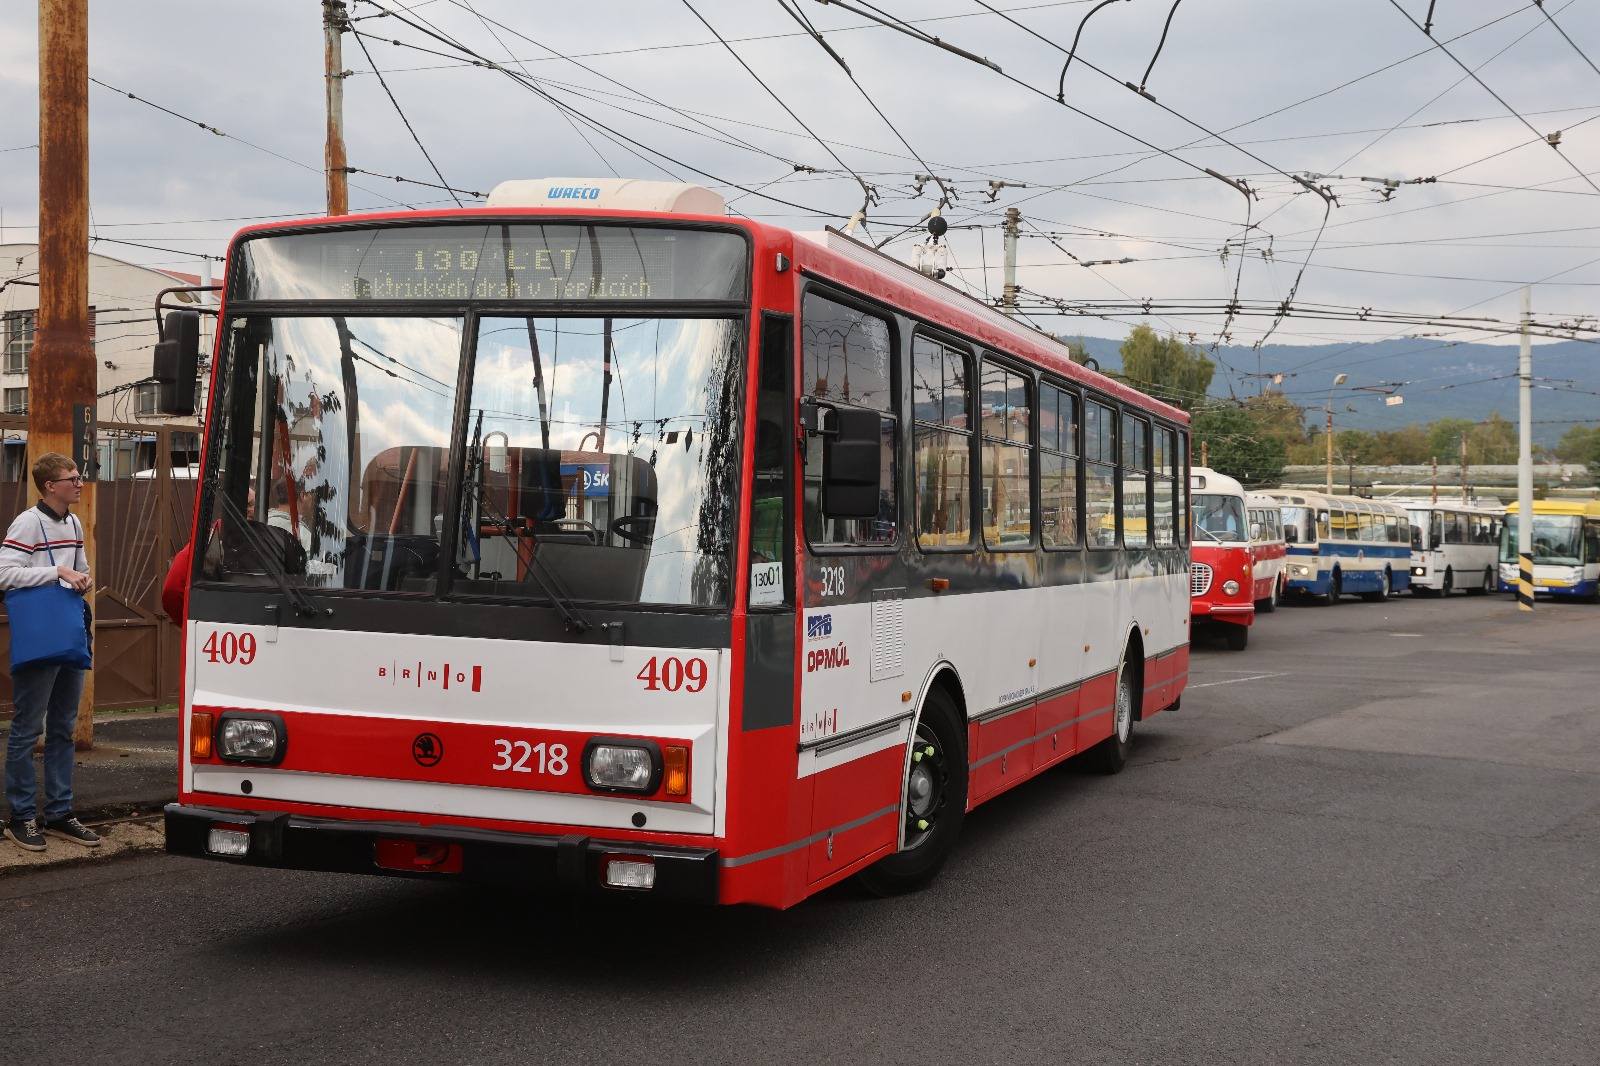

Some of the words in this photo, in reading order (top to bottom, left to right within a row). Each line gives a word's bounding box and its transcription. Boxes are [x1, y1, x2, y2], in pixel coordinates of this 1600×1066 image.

[548, 187, 601, 199] WAECO
[415, 250, 478, 270] 130
[508, 249, 576, 269] LET
[476, 277, 521, 297] drah
[820, 566, 845, 597] 3218
[201, 631, 257, 666] 409
[807, 641, 850, 673] DPMÚL
[636, 656, 708, 693] 409
[492, 738, 570, 776] 3218
